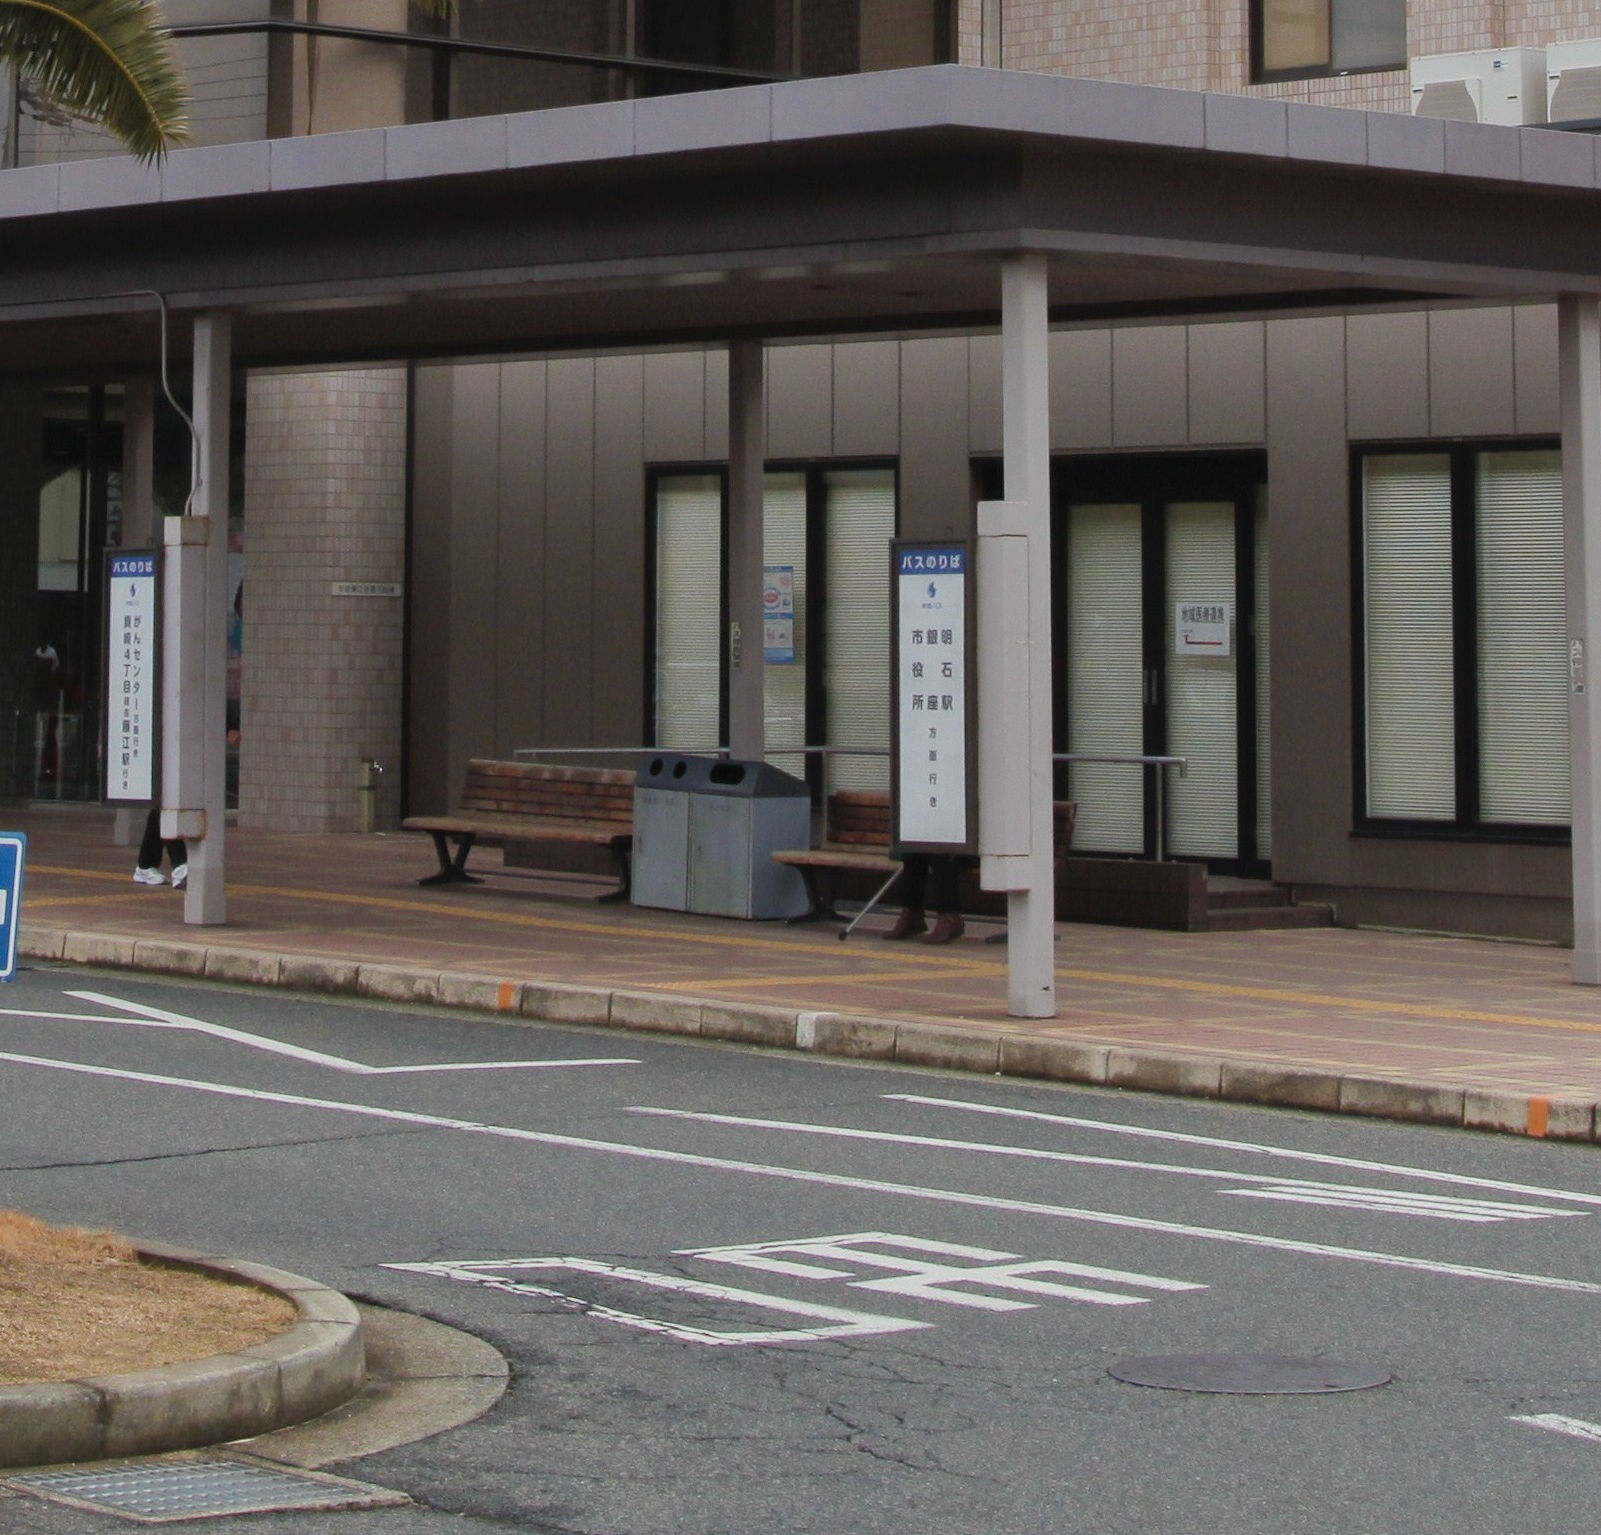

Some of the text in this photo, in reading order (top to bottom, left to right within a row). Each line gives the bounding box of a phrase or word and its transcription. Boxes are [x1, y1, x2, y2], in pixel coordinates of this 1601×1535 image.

[112, 560, 154, 574] バスのりば
[902, 554, 962, 569] バスのりば
[911, 628, 924, 711] 市役所
[941, 628, 954, 711] 明石駅
